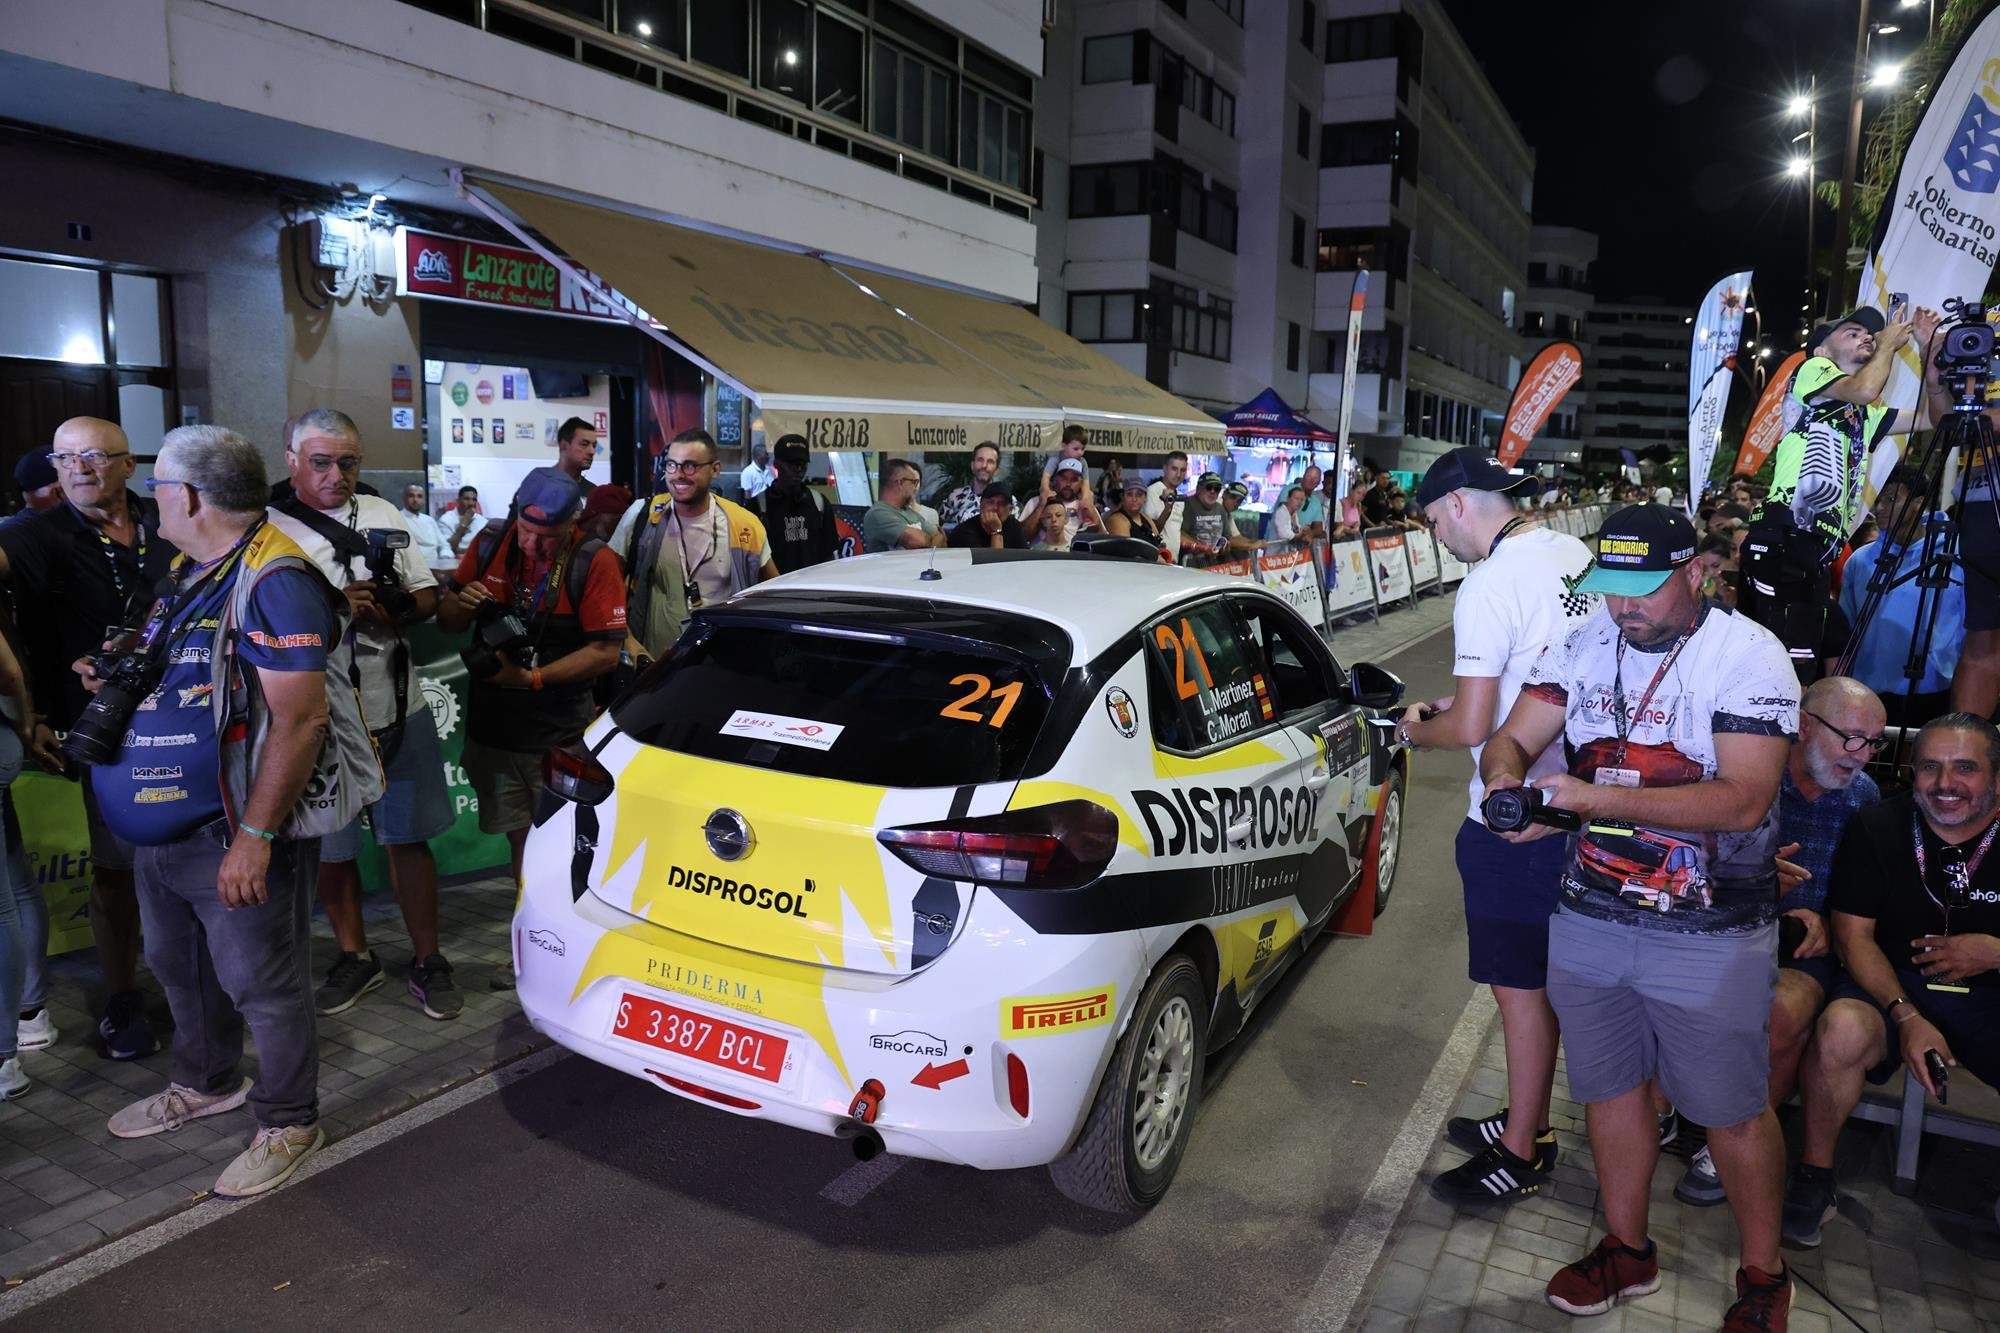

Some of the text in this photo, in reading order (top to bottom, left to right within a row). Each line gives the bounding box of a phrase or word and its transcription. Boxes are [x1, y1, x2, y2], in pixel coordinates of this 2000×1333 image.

[1919, 206, 1996, 268] Canarias
[463, 244, 556, 293] Lanzarote
[805, 417, 870, 449] KEBAB
[907, 420, 967, 447] Lanzarote
[998, 422, 1041, 449] KEBAB
[1124, 428, 1173, 450] Venecia
[1175, 434, 1224, 451] TRATTORIA
[1156, 616, 1213, 700] 21
[940, 672, 1023, 729] 21
[1581, 696, 1599, 710] Los
[734, 717, 775, 728] ARMAS
[1207, 709, 1252, 743] C.Moran
[1131, 786, 1319, 857] DISPROSOL
[668, 865, 807, 918] DISPROSOL
[647, 958, 764, 1004] PRIDERMA
[1012, 993, 1107, 1029] PIRELLI
[617, 1001, 767, 1071] S 3387 BCL
